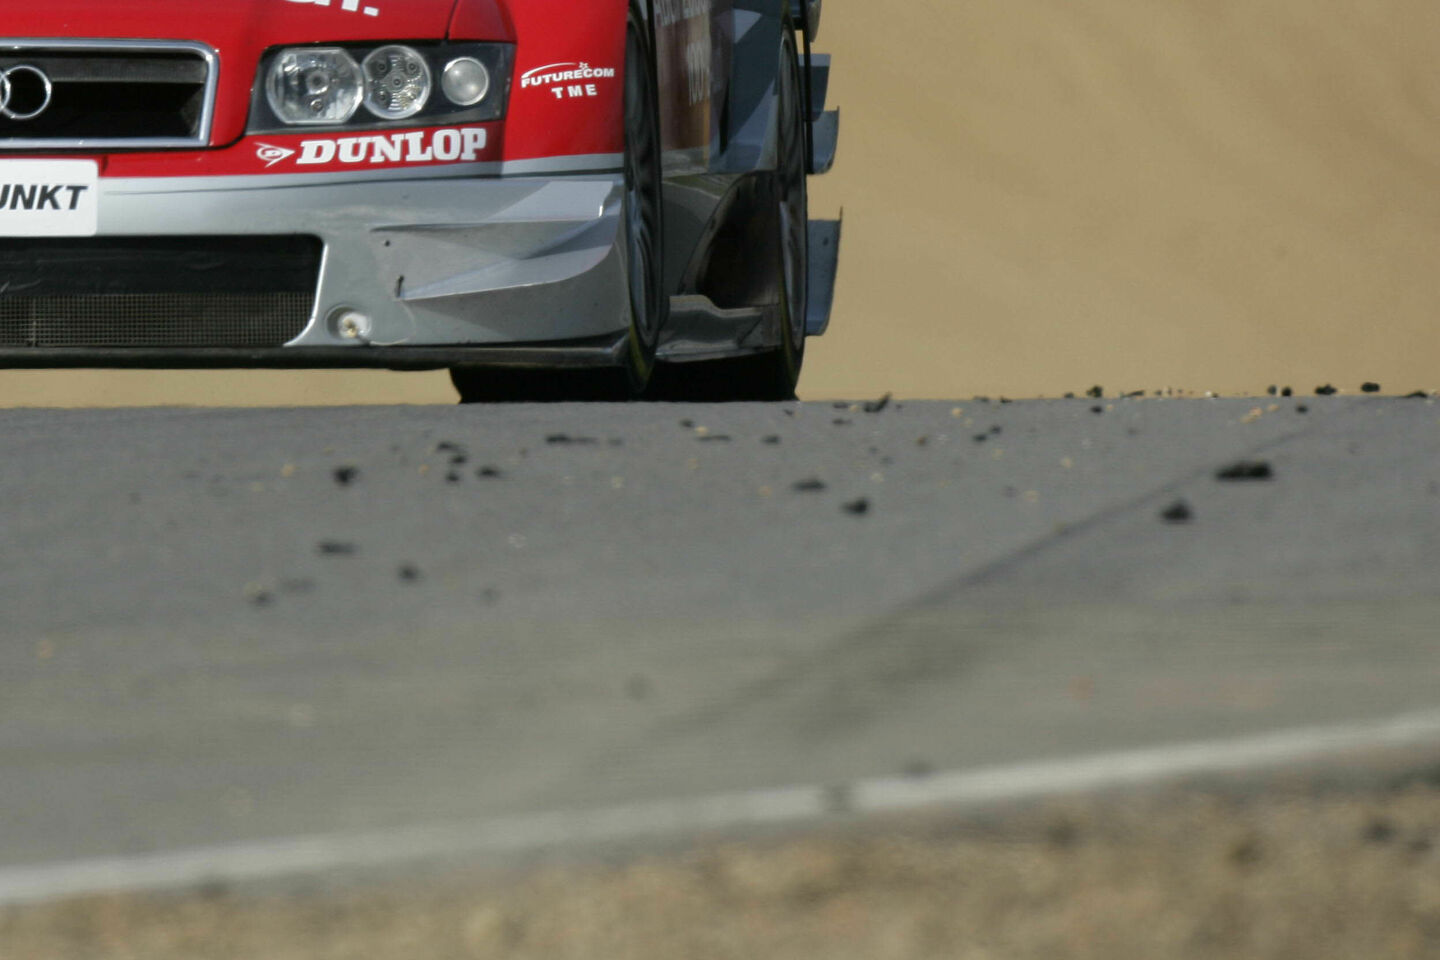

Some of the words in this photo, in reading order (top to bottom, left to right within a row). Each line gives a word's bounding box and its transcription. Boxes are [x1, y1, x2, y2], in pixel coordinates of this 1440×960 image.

[521, 68, 615, 88] FUTURECOM
[551, 84, 597, 99] TME
[296, 127, 487, 164] DUNLOP
